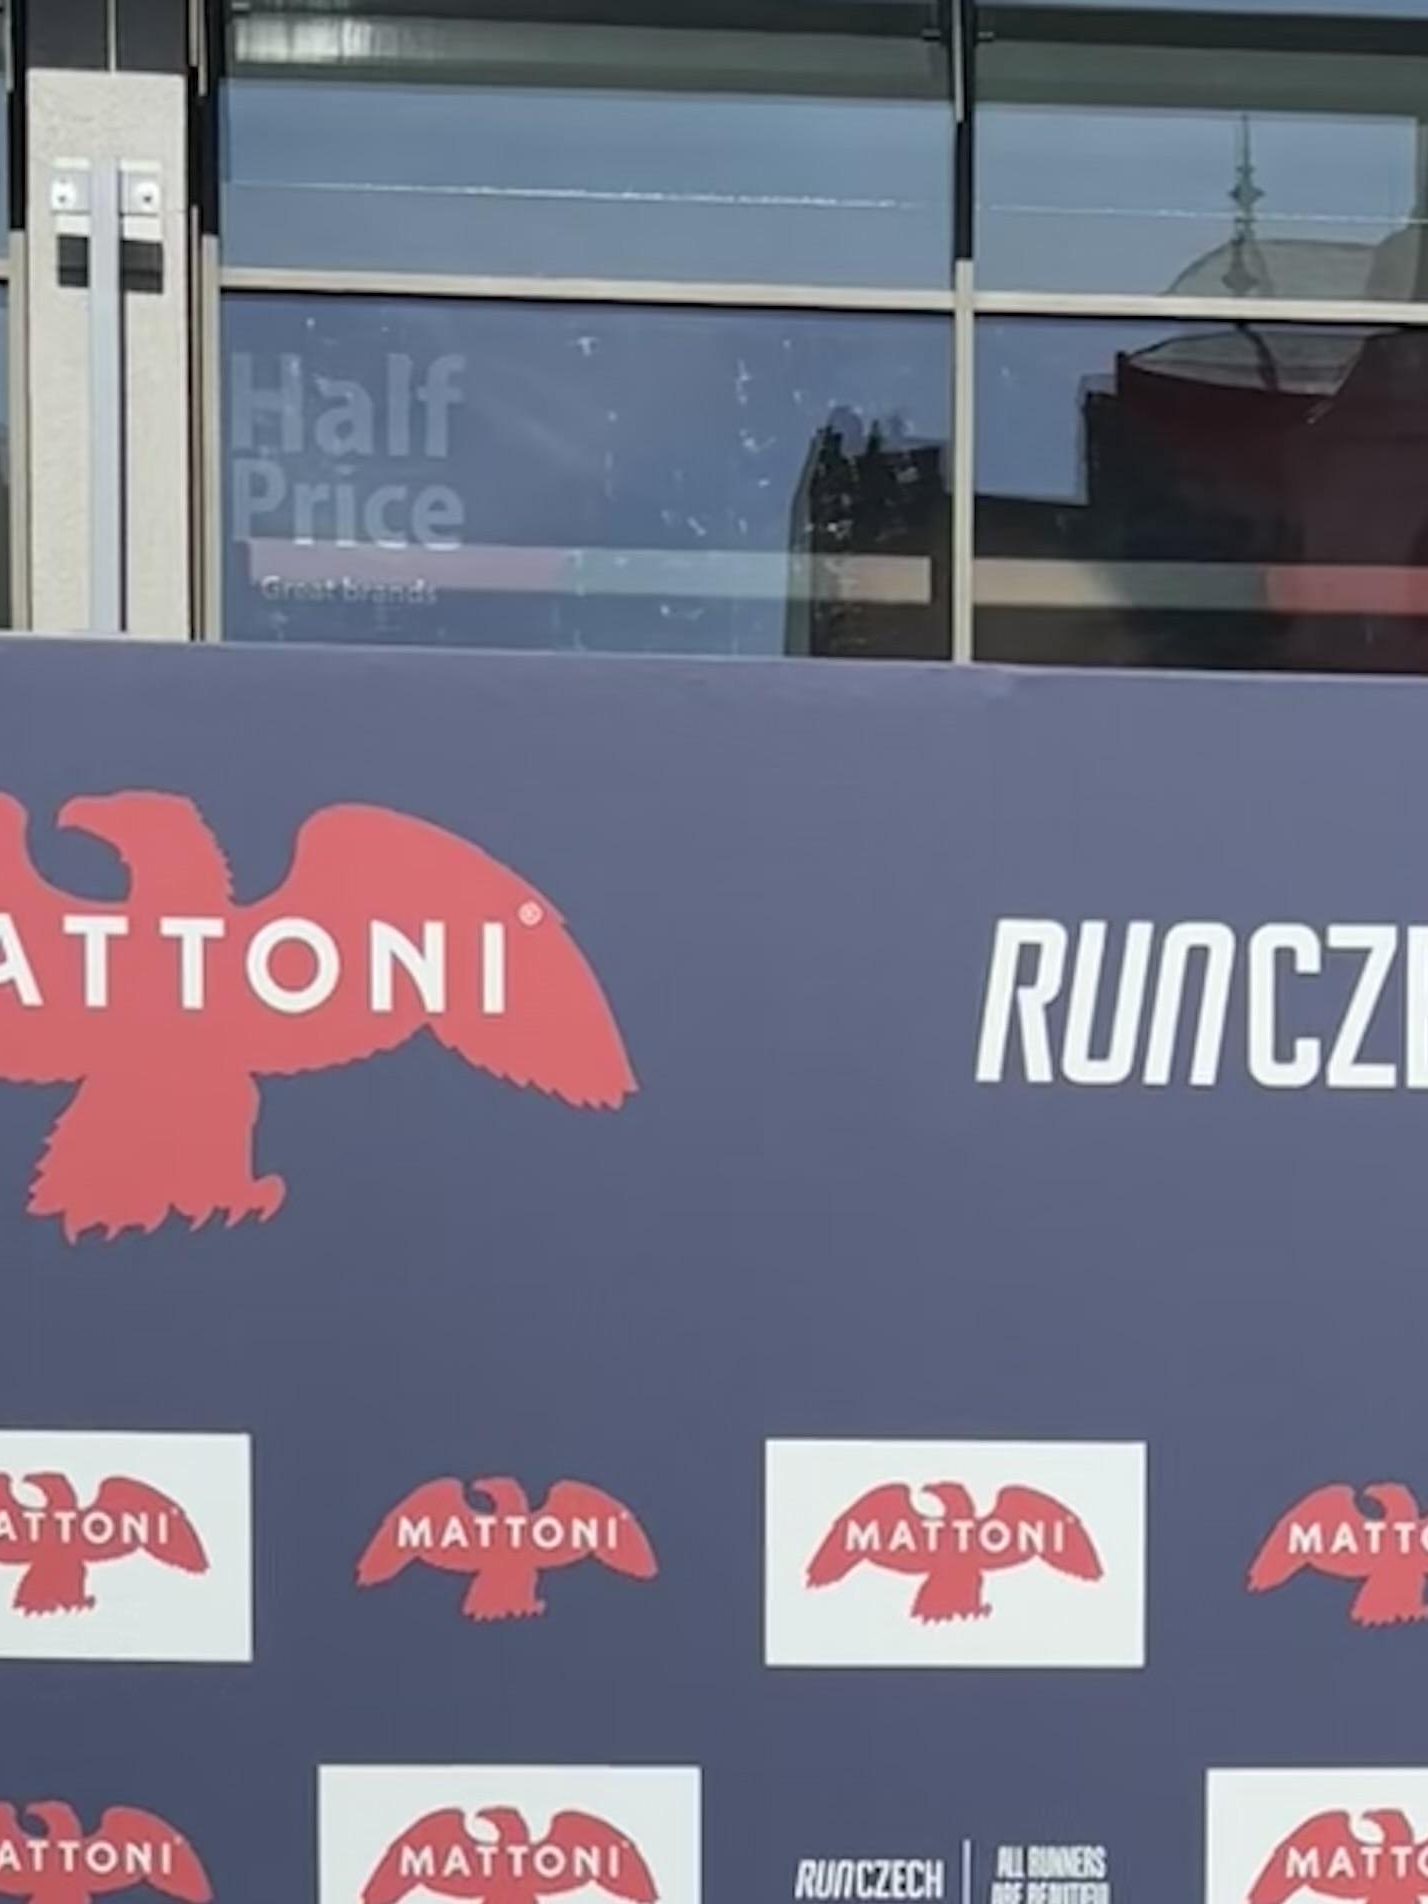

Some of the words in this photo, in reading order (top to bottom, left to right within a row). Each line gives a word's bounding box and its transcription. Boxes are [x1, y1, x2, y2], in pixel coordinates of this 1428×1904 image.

[230, 352, 467, 457] Half
[231, 457, 465, 550] Price
[260, 575, 334, 600] Great
[341, 575, 439, 604] brands
[398, 1515, 617, 1549] MATTONI
[846, 1519, 1064, 1553] MATTONI
[400, 1844, 619, 1878] MATTONI
[996, 1845, 1023, 1879] ALL
[1026, 1845, 1107, 1879] RUNNERS
[794, 1858, 945, 1900] RUNCZECH
